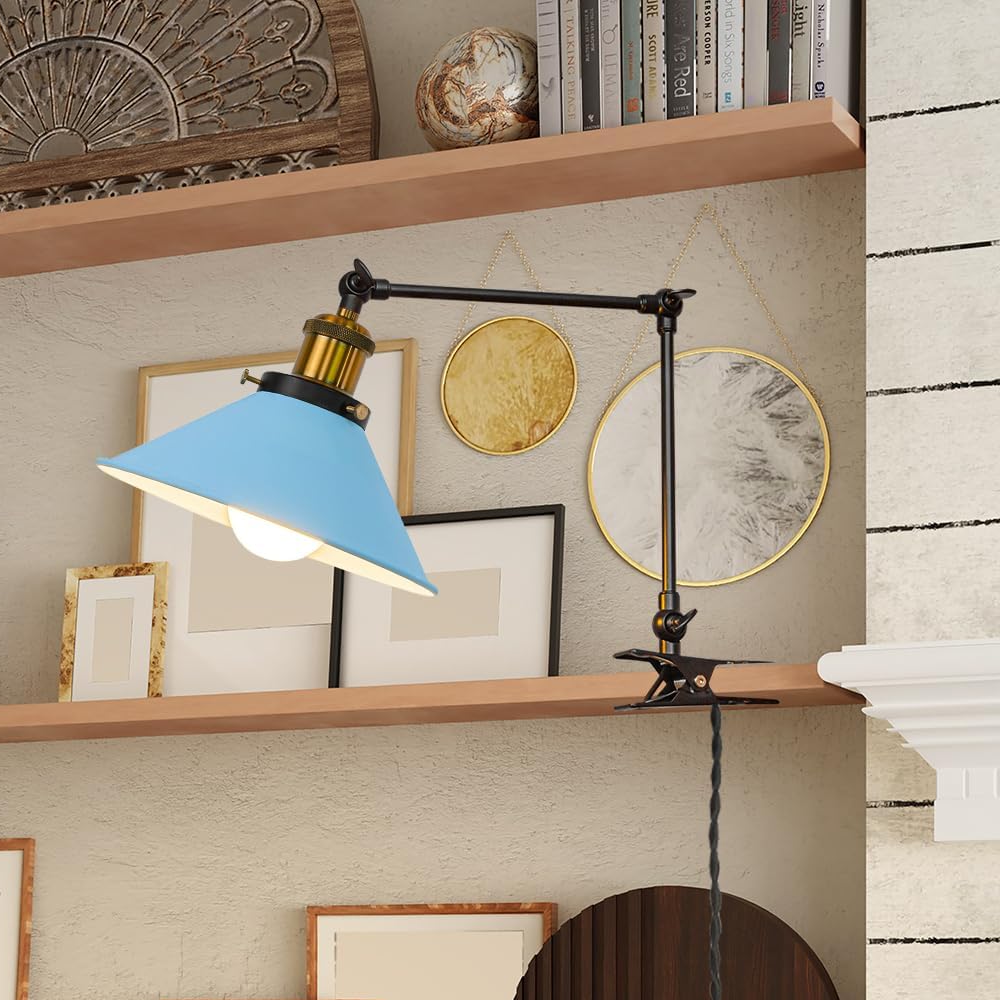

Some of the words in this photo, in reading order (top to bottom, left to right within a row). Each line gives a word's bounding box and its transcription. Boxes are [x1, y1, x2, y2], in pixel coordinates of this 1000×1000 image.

[724, 21, 734, 31] in
[817, 3, 825, 39] Nicholas
[566, 15, 577, 75] TALKING
[648, 34, 657, 63] SCOTT
[703, 32, 712, 66] COOPER
[724, 34, 735, 48] Six
[815, 41, 825, 69] Sparks
[673, 66, 692, 98] Red
[721, 50, 735, 83] Songs
[566, 80, 577, 121] PEACE
